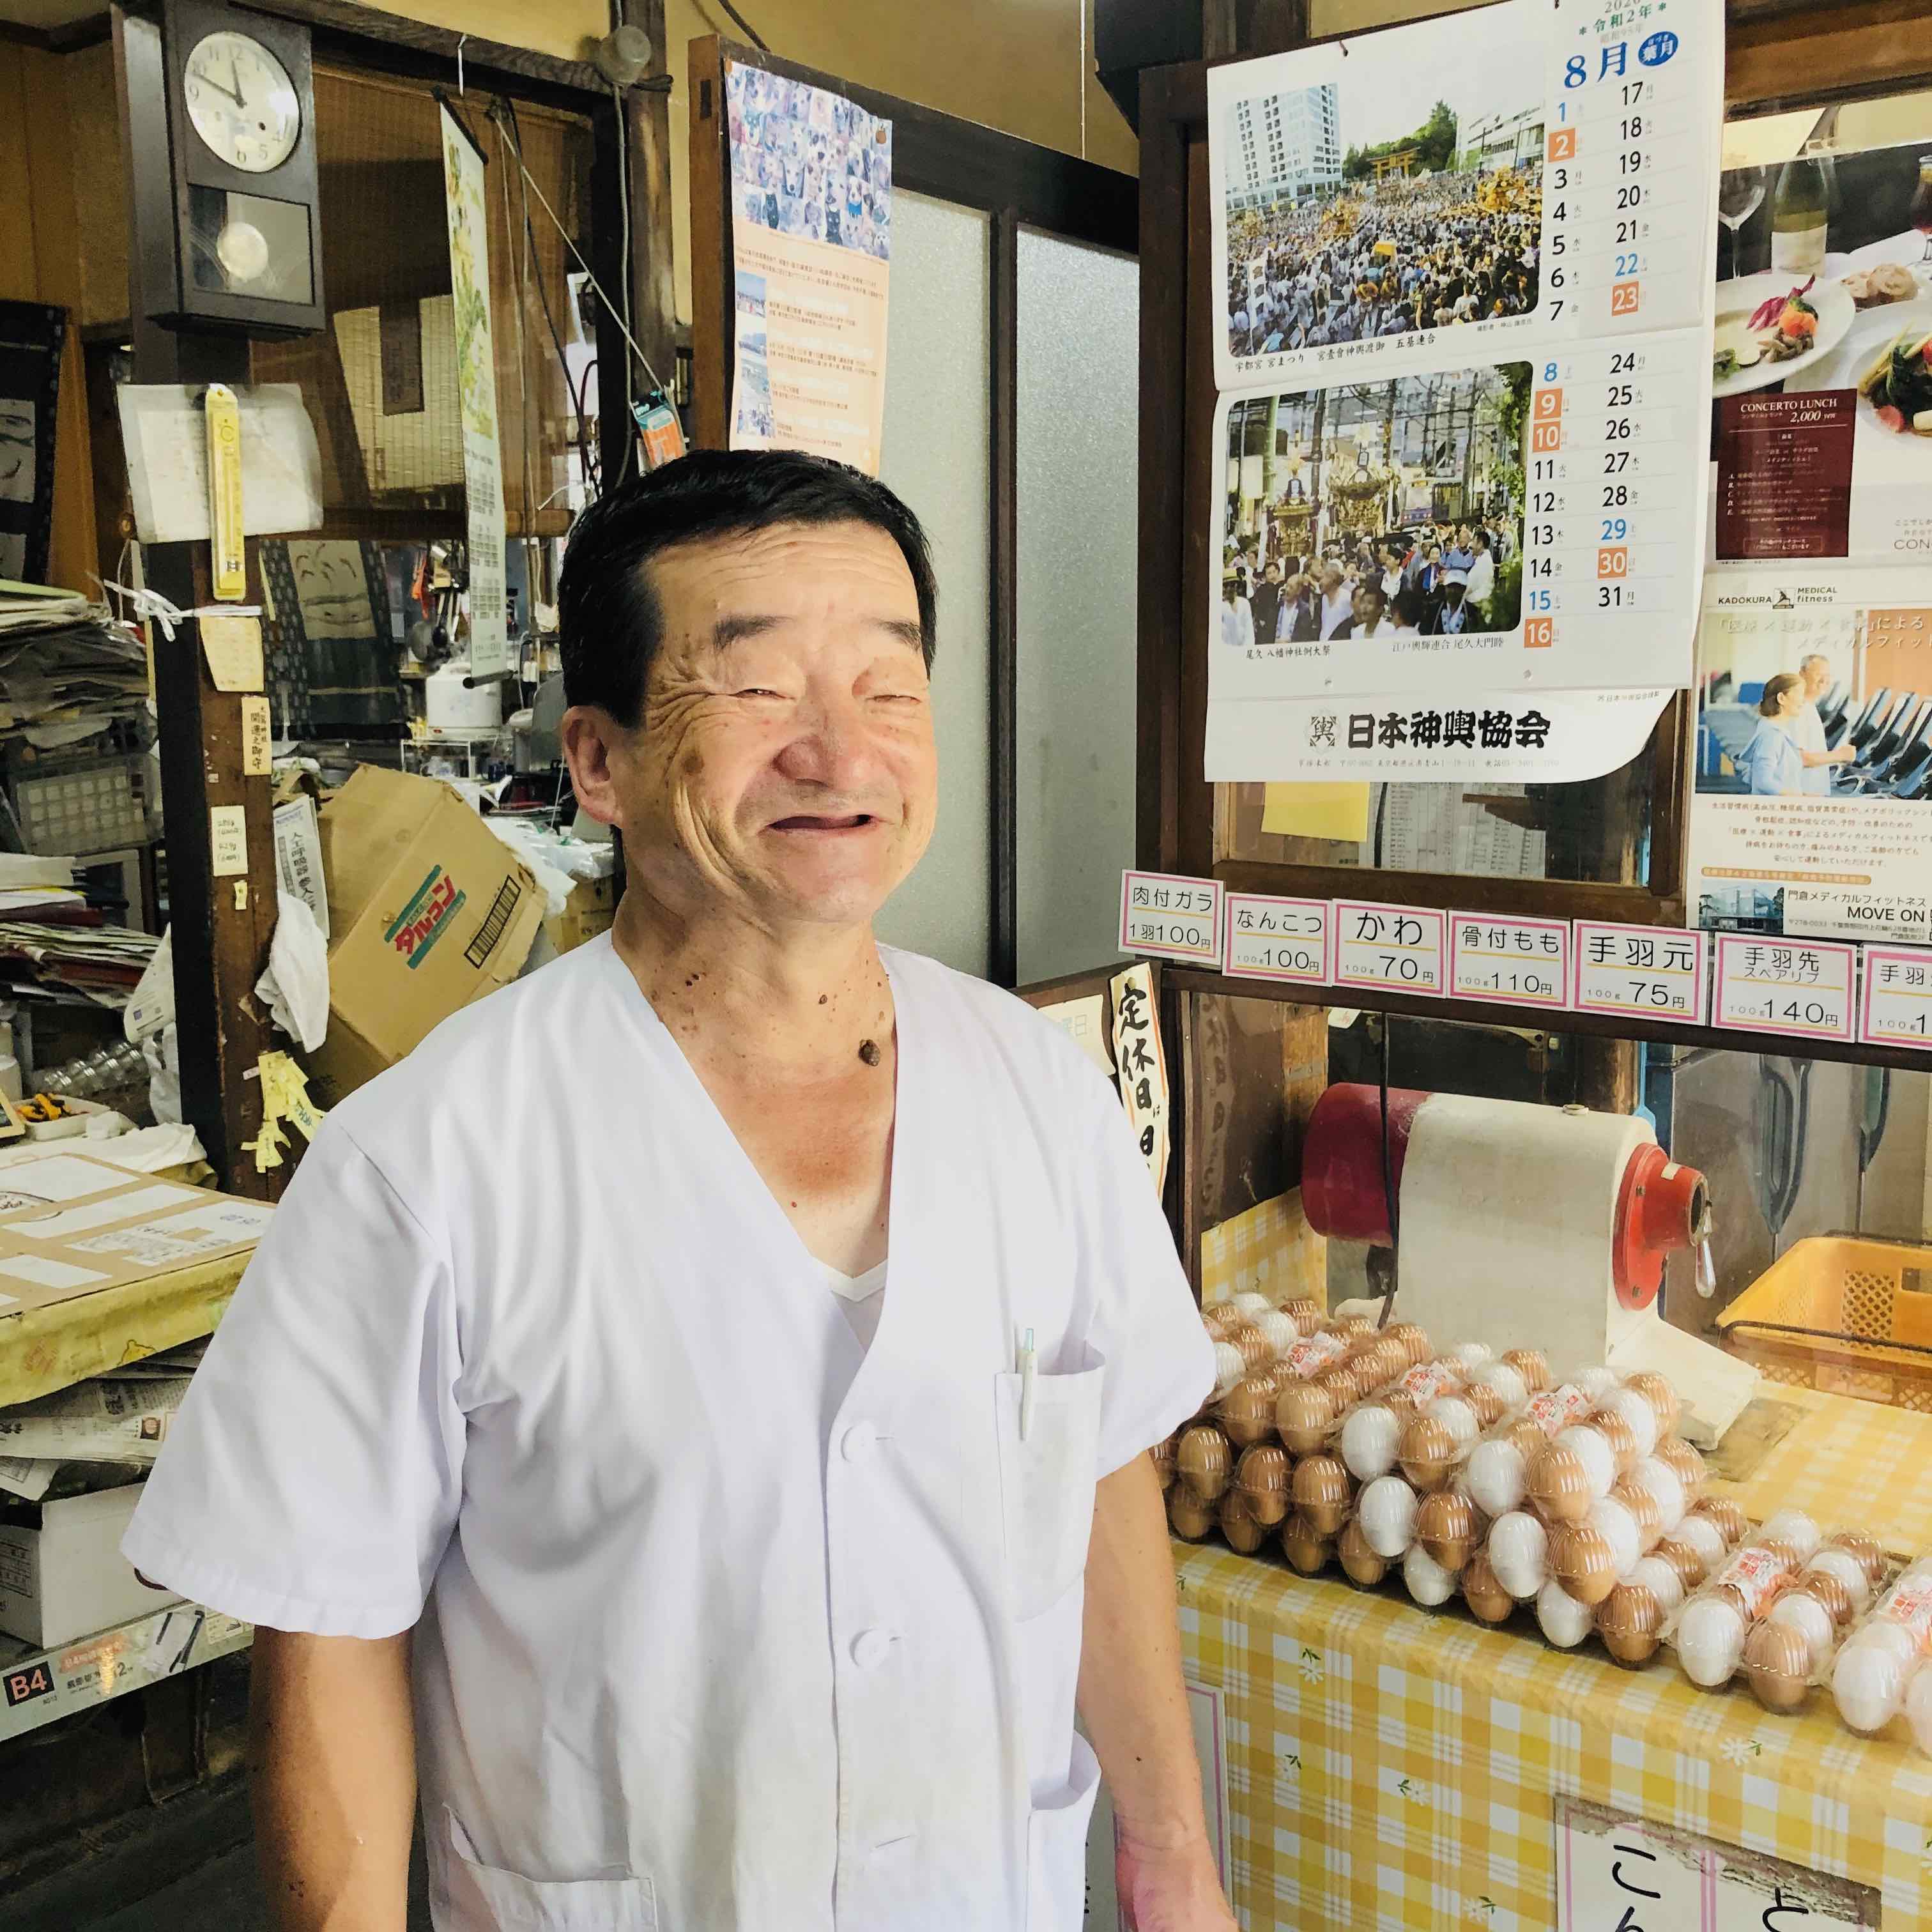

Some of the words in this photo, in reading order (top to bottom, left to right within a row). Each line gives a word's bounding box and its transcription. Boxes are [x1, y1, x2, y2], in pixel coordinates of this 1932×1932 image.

[1593, 4, 1652, 33] 令和2年
[1621, 81, 1643, 105] 17
[1558, 102, 1566, 122] 1
[1621, 116, 1642, 140] 18
[1554, 134, 1569, 157] 2
[1620, 151, 1641, 174] 19
[1554, 169, 1567, 189] 3
[1617, 185, 1640, 210] 20
[1552, 202, 1567, 221] 4
[1616, 220, 1636, 243] 21
[1552, 235, 1565, 255] 5
[1615, 253, 1638, 277] 22
[1551, 268, 1564, 288] 6
[1613, 287, 1637, 311] 23
[1550, 300, 1563, 321] 7
[1544, 362, 1557, 381] 8
[1609, 353, 1635, 374] 24
[1541, 394, 1556, 415] 9
[1607, 385, 1632, 407] 25
[1740, 401, 1798, 413] CONCERTO
[1800, 398, 1837, 409] LUNCH
[1790, 411, 1821, 424] 2,000
[1536, 426, 1559, 447] 10
[1605, 418, 1630, 440] 26
[1535, 459, 1554, 480] 11
[1604, 452, 1629, 473] 27
[1533, 492, 1554, 512] 12
[1602, 486, 1627, 507] 28
[1532, 525, 1554, 546] 13
[1601, 518, 1626, 540] 29
[1530, 558, 1552, 578] 14
[1599, 551, 1626, 574] 30
[1529, 590, 1551, 611] 15
[1598, 586, 1621, 607] 31
[1718, 596, 1772, 605] KADOKURA
[1797, 594, 1834, 603] fitness
[1528, 622, 1550, 644] 16
[1347, 710, 1551, 749] 日本神輿協会
[1133, 885, 1212, 912] 肉付ガラ
[1788, 889, 1927, 907] 門倉メディカルフィットネス
[1237, 909, 1322, 933] なんこつ
[1848, 906, 1895, 921] MOVE
[1900, 909, 1925, 923] ON
[1356, 912, 1423, 946] かわ
[1462, 925, 1560, 954] 骨付もも
[1263, 948, 1319, 972] 100円
[1588, 936, 1694, 971] 手羽元
[1744, 946, 1820, 972] 手羽先
[1379, 955, 1434, 983] 70円
[1880, 964, 1932, 986] 手羽
[1491, 972, 1552, 995] 110円
[1629, 981, 1685, 1009] 75円
[1763, 999, 1839, 1027] 140円
[10, 1668, 48, 1701] B4
